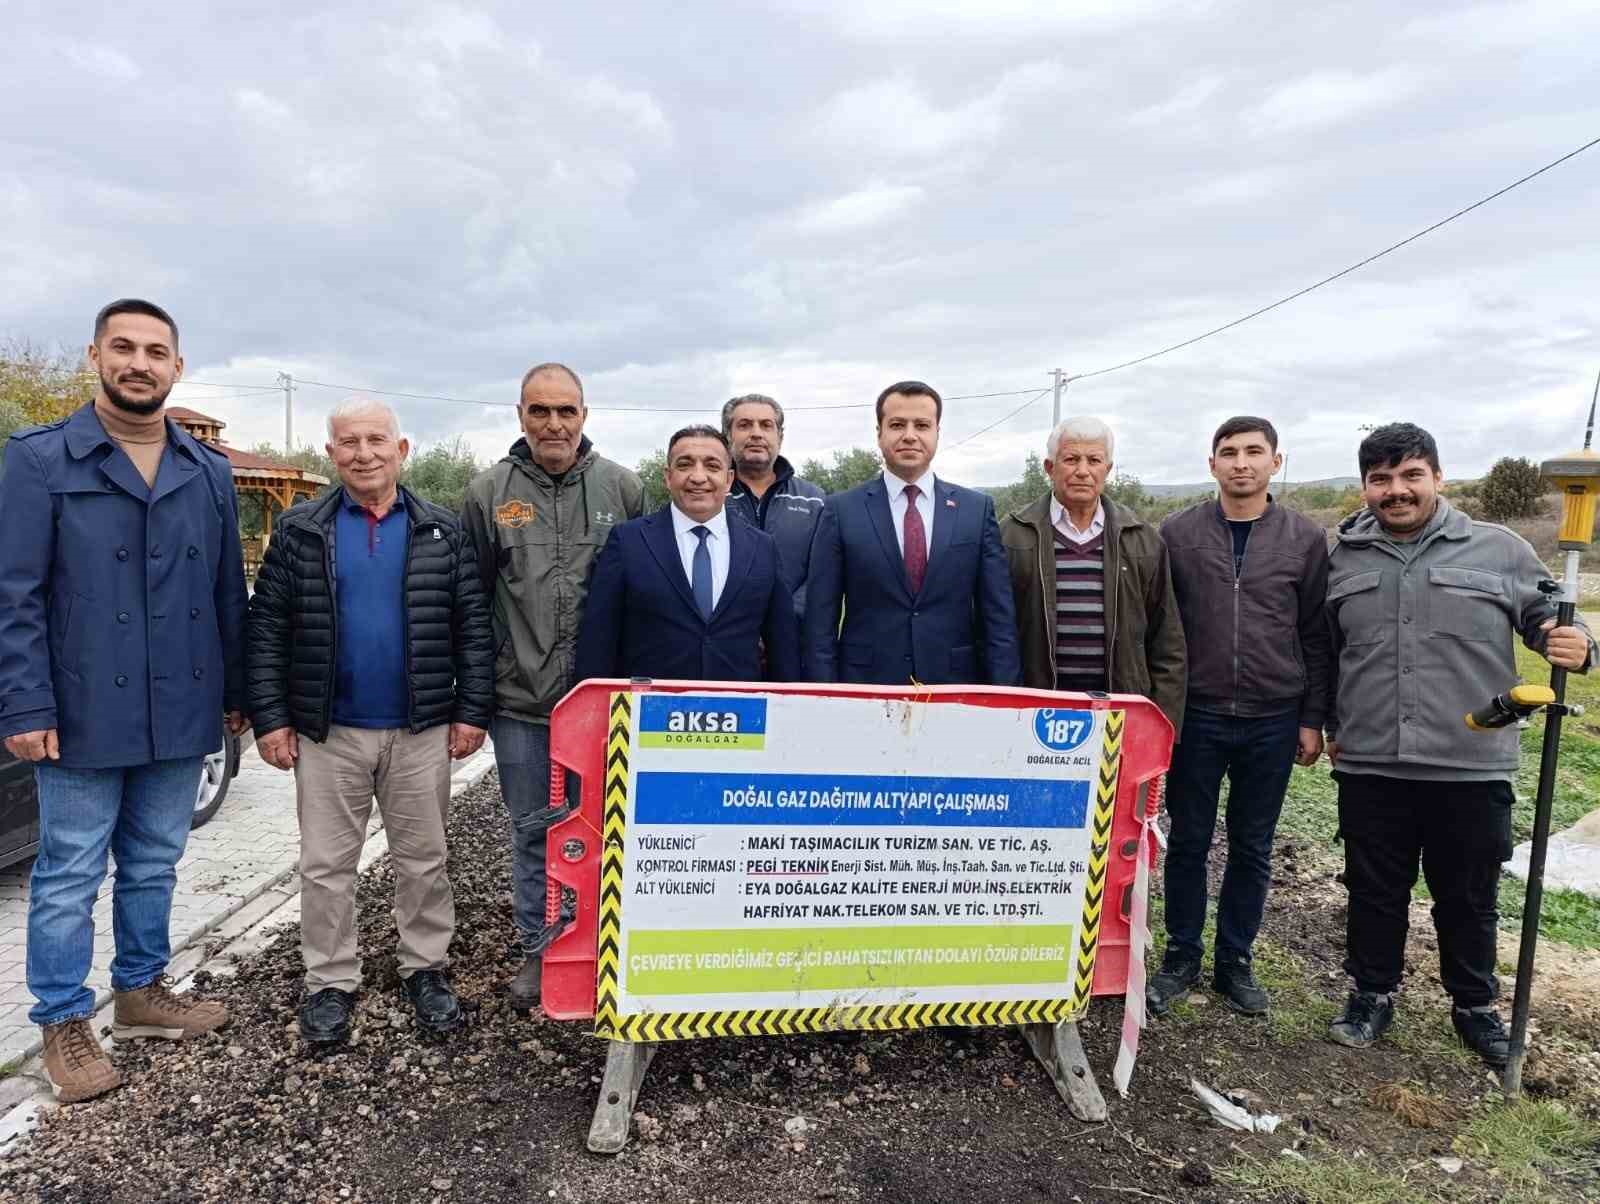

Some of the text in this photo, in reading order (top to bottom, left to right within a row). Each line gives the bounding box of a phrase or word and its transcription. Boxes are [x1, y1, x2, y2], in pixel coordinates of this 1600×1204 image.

[668, 711, 738, 732] aksa
[1045, 719, 1085, 744] 187
[665, 734, 739, 744] DOĞALGAZ
[722, 784, 1009, 816] DOĞAL GAZ DAĞITIM ALTYAPI ÇALIŞMASI
[638, 834, 696, 850] YÜKLENİCİ
[747, 835, 785, 850] MAKİ
[789, 837, 880, 853] TAŞIMACILIK
[884, 835, 938, 851] TURİZM
[941, 838, 973, 851] SAN.
[978, 838, 996, 851] VE
[999, 836, 1026, 852] TİC.
[1030, 839, 1052, 854] AŞ.
[636, 859, 689, 874] KONTROL
[746, 857, 777, 873] PEGİ
[780, 857, 829, 873] TEKNİK
[831, 859, 861, 875] Enerji
[863, 860, 887, 873] Sist.
[889, 860, 913, 873] Müh.
[916, 860, 940, 876] Müş.
[991, 860, 1013, 873] San.
[1015, 862, 1027, 873] ve
[635, 880, 655, 895] ALT
[658, 878, 716, 895] YÜKLENİCİ
[745, 882, 771, 896] EYA
[775, 880, 847, 895] DOĞALGAZ
[851, 879, 898, 894] KALİTE
[902, 880, 948, 894] ENERJİ
[744, 902, 809, 918] HAFRİYAT
[910, 904, 940, 916] SAN.
[944, 903, 961, 916] VE
[965, 901, 989, 916] TİC.
[630, 952, 692, 976] ÇEVREYE
[695, 947, 774, 969] VERDİĞİMİZ
[935, 947, 982, 963] DOLAYI
[984, 944, 1018, 962] ÖZÜR
[1020, 943, 1064, 961] DİLERİZ
